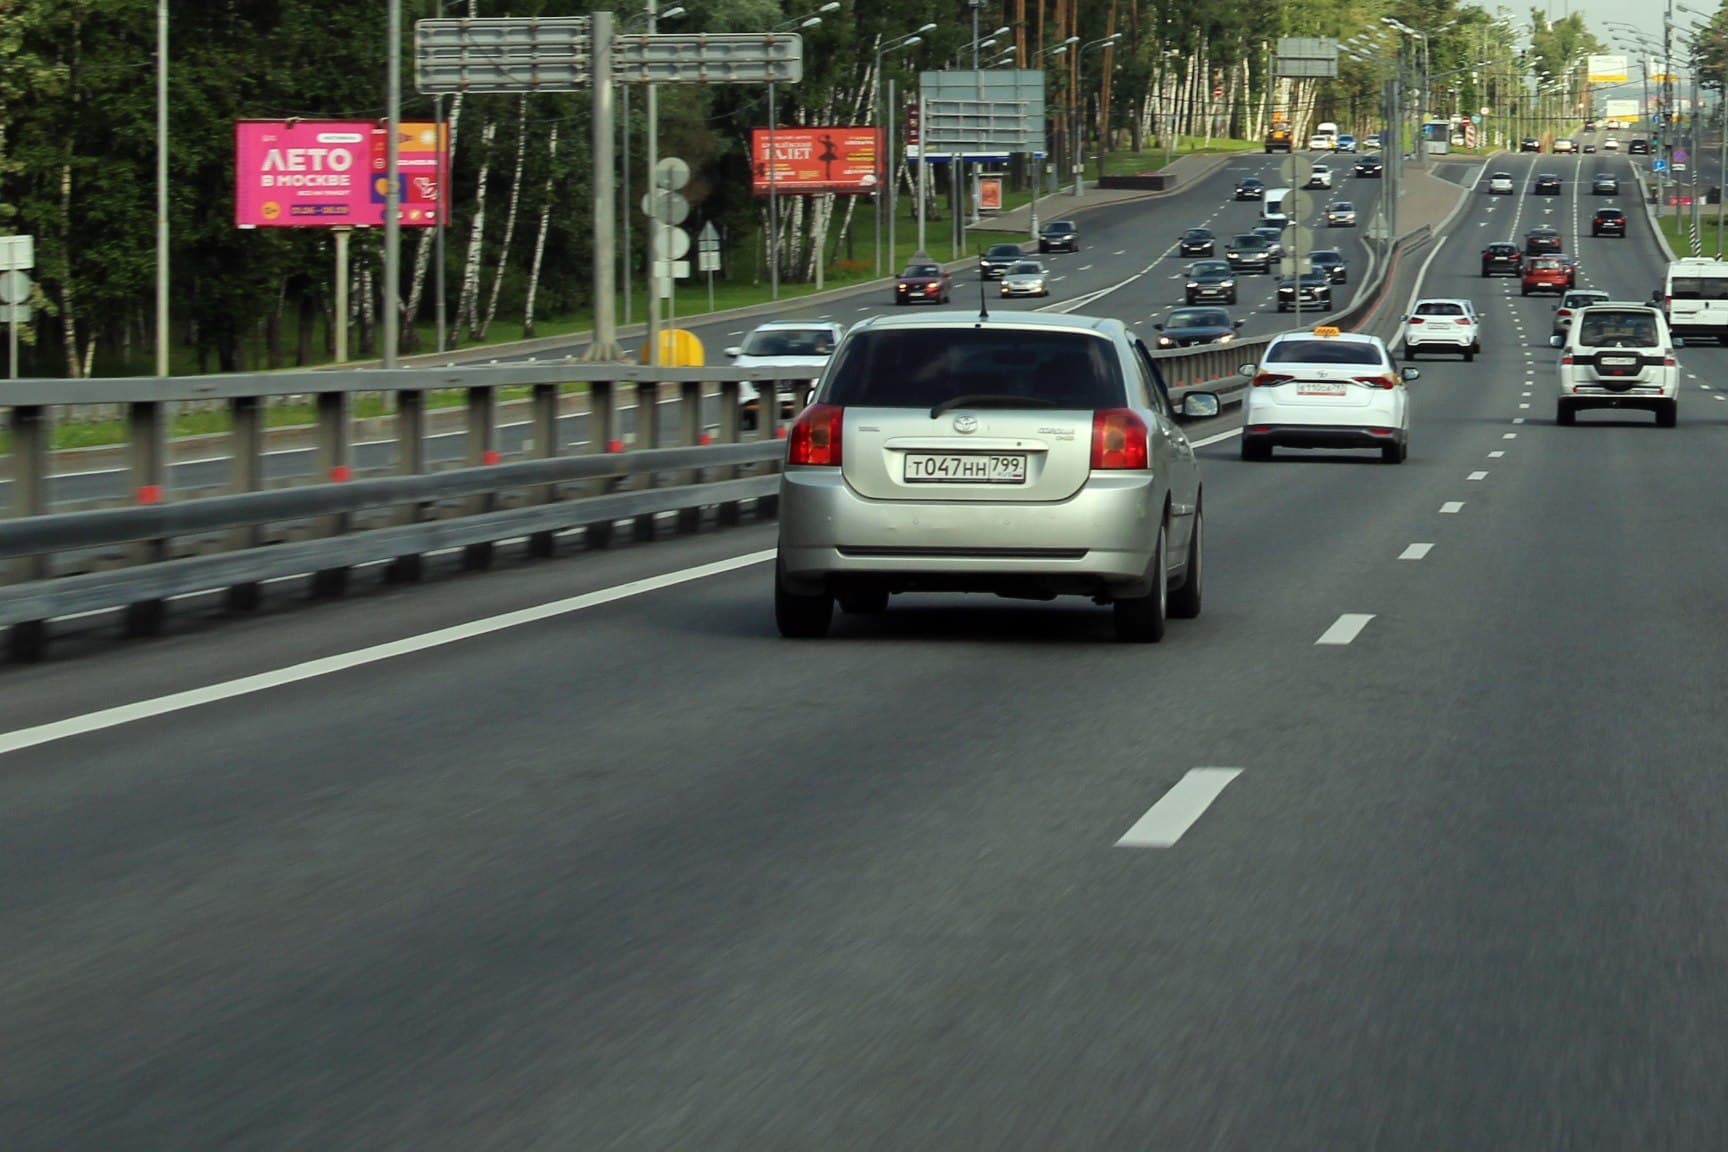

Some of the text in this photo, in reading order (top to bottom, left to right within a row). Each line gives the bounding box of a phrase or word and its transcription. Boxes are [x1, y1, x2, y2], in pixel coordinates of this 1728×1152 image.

[261, 147, 353, 172] ЛЕТО
[261, 174, 351, 187] В МОСКВЕ
[991, 457, 1020, 472] 799
